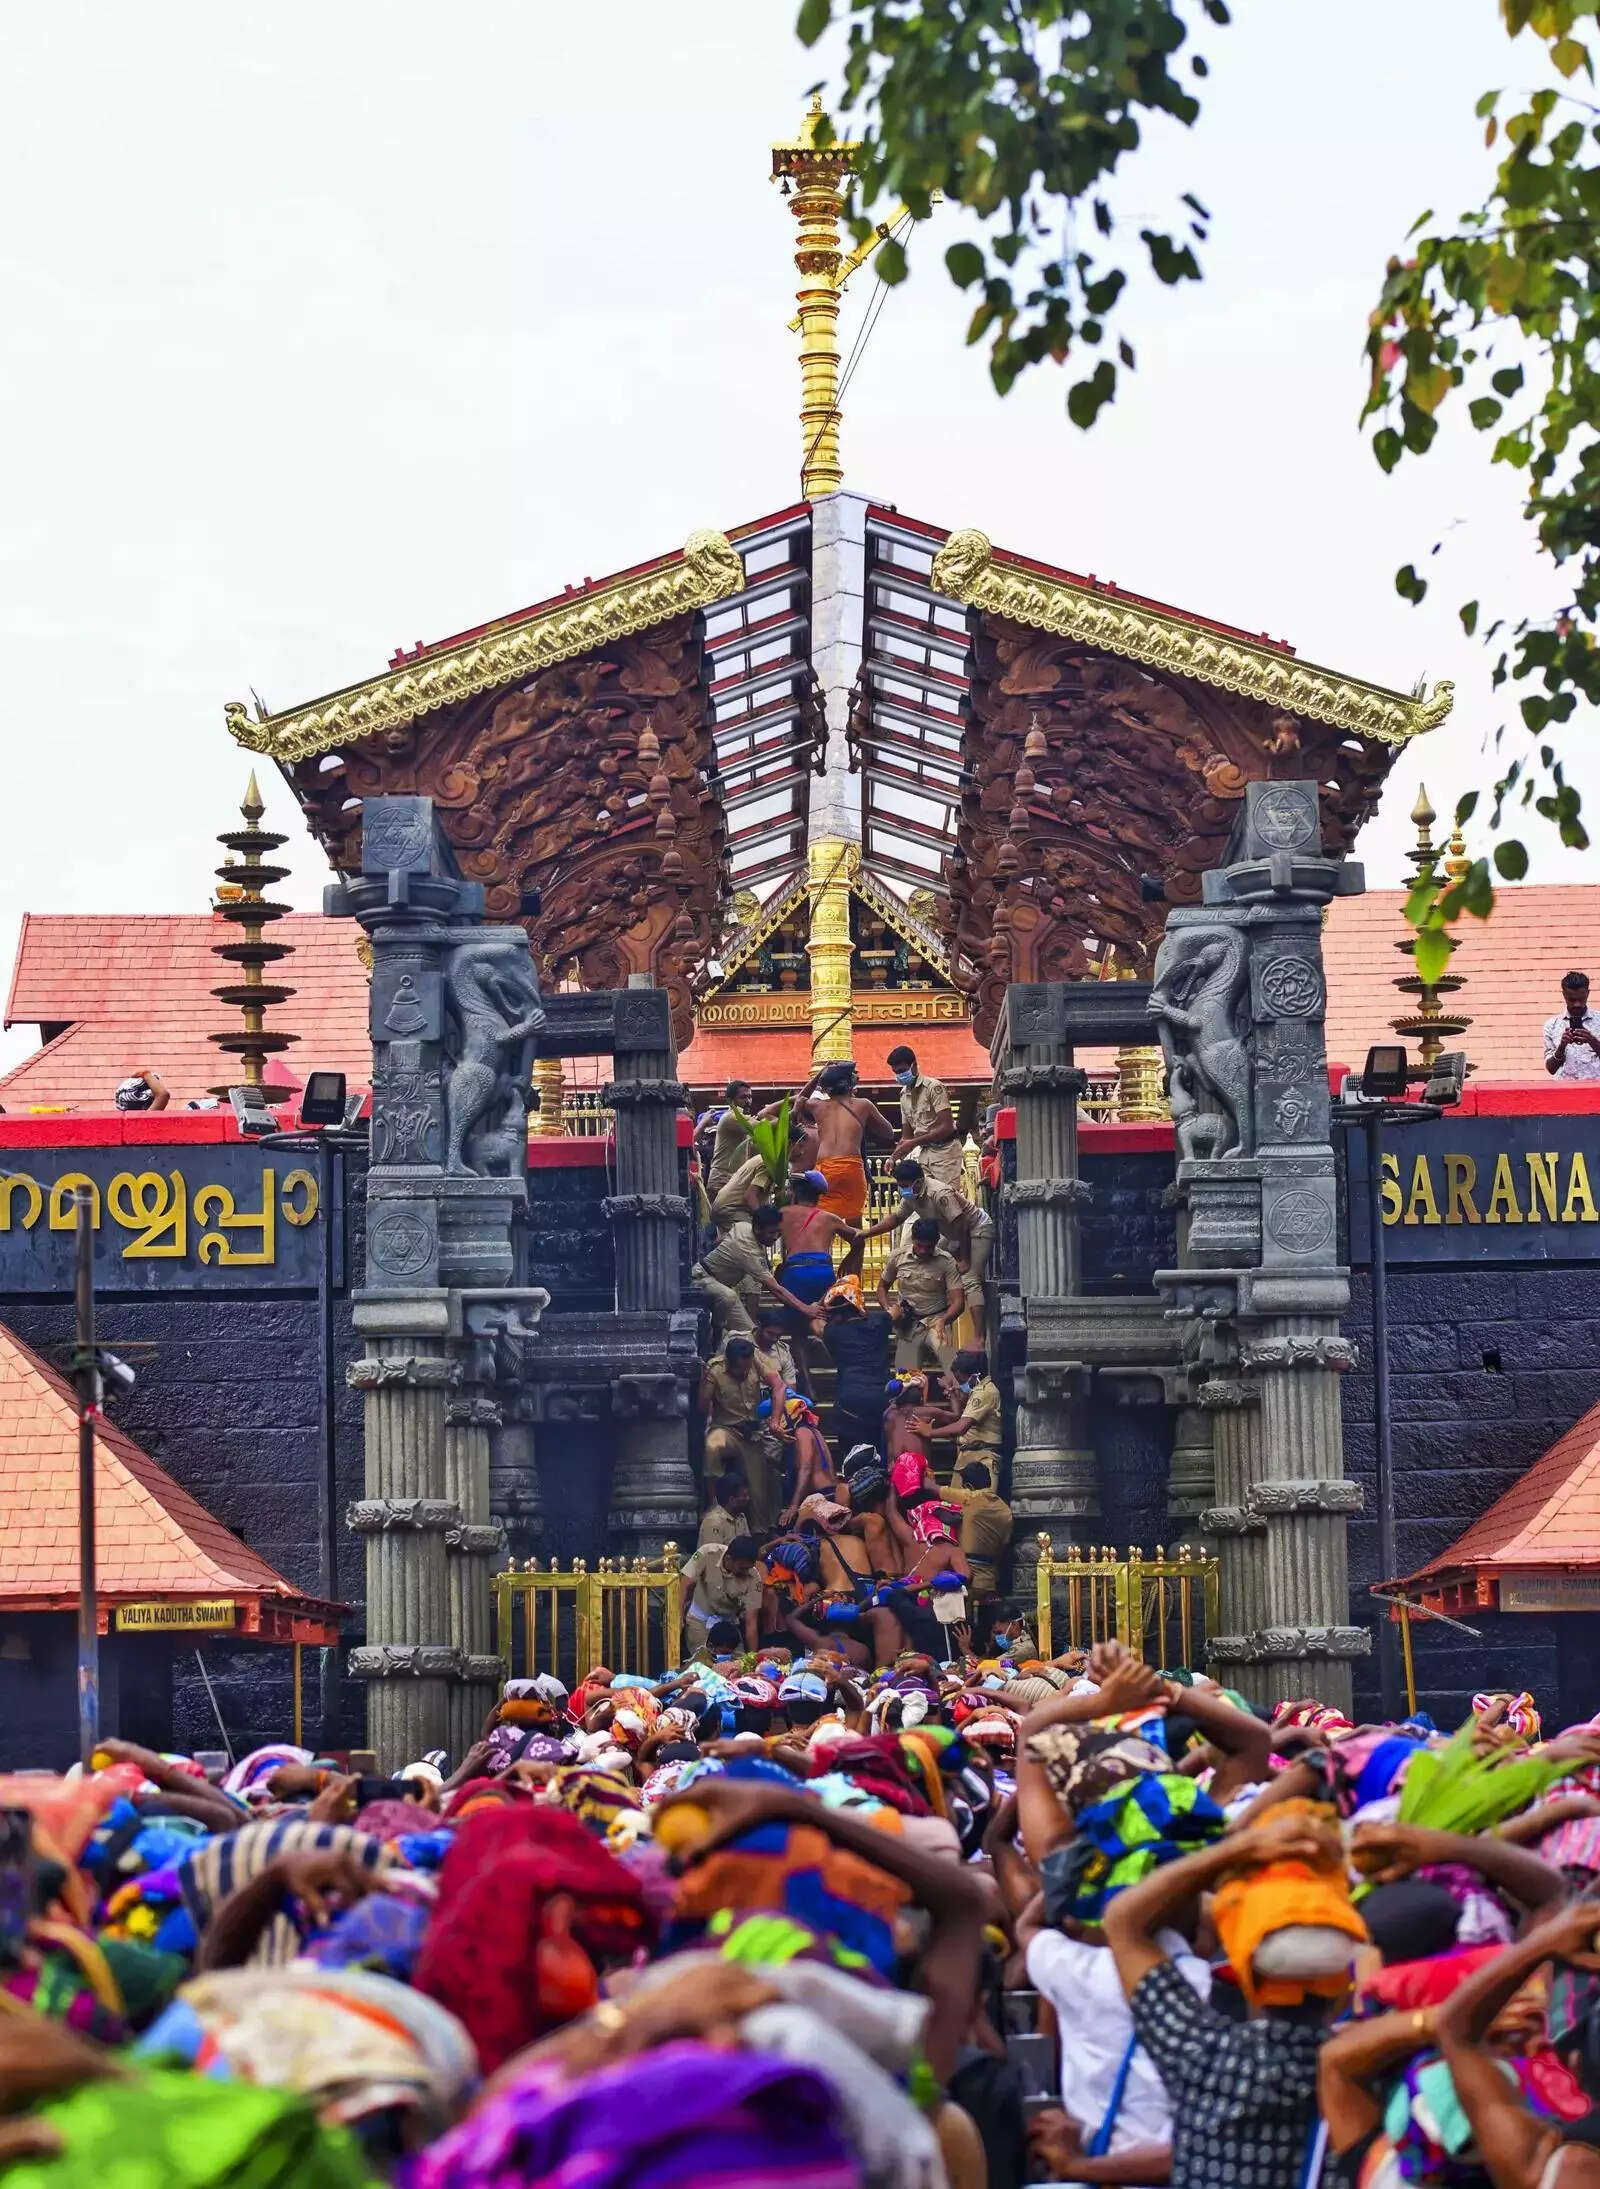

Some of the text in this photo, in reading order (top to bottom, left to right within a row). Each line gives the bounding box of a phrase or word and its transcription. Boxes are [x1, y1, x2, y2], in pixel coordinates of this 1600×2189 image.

[1381, 1152, 1600, 1226] SARANA
[121, 1606, 229, 1624] VALIYA KADUTHA SWAMY
